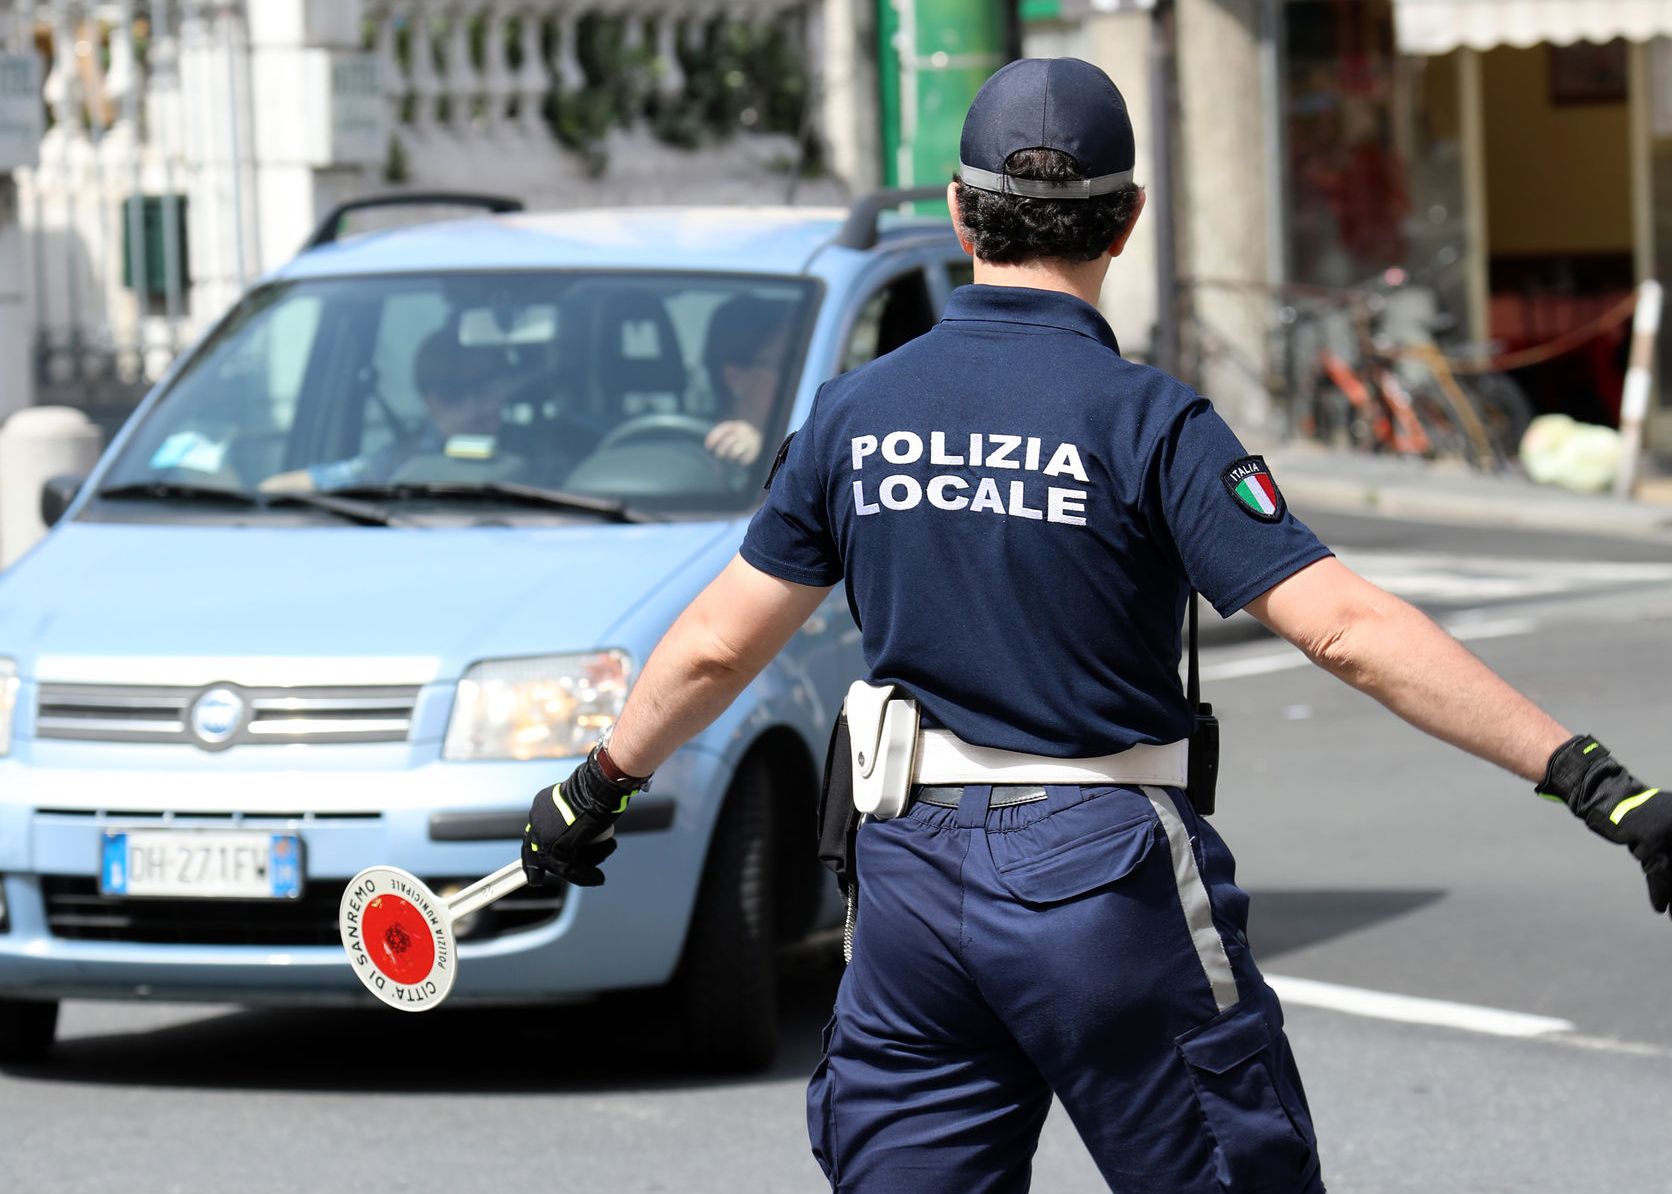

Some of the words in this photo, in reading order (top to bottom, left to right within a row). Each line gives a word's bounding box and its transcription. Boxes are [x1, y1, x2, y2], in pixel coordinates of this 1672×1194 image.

[851, 430, 1090, 482] POLIZIA
[1229, 462, 1260, 482] ITALIA
[852, 474, 1088, 526] LOCALE
[346, 879, 376, 967] SANREMO
[391, 878, 439, 925] MUNICIPALE
[435, 928, 447, 970] POLIZIA
[369, 970, 386, 990] DI
